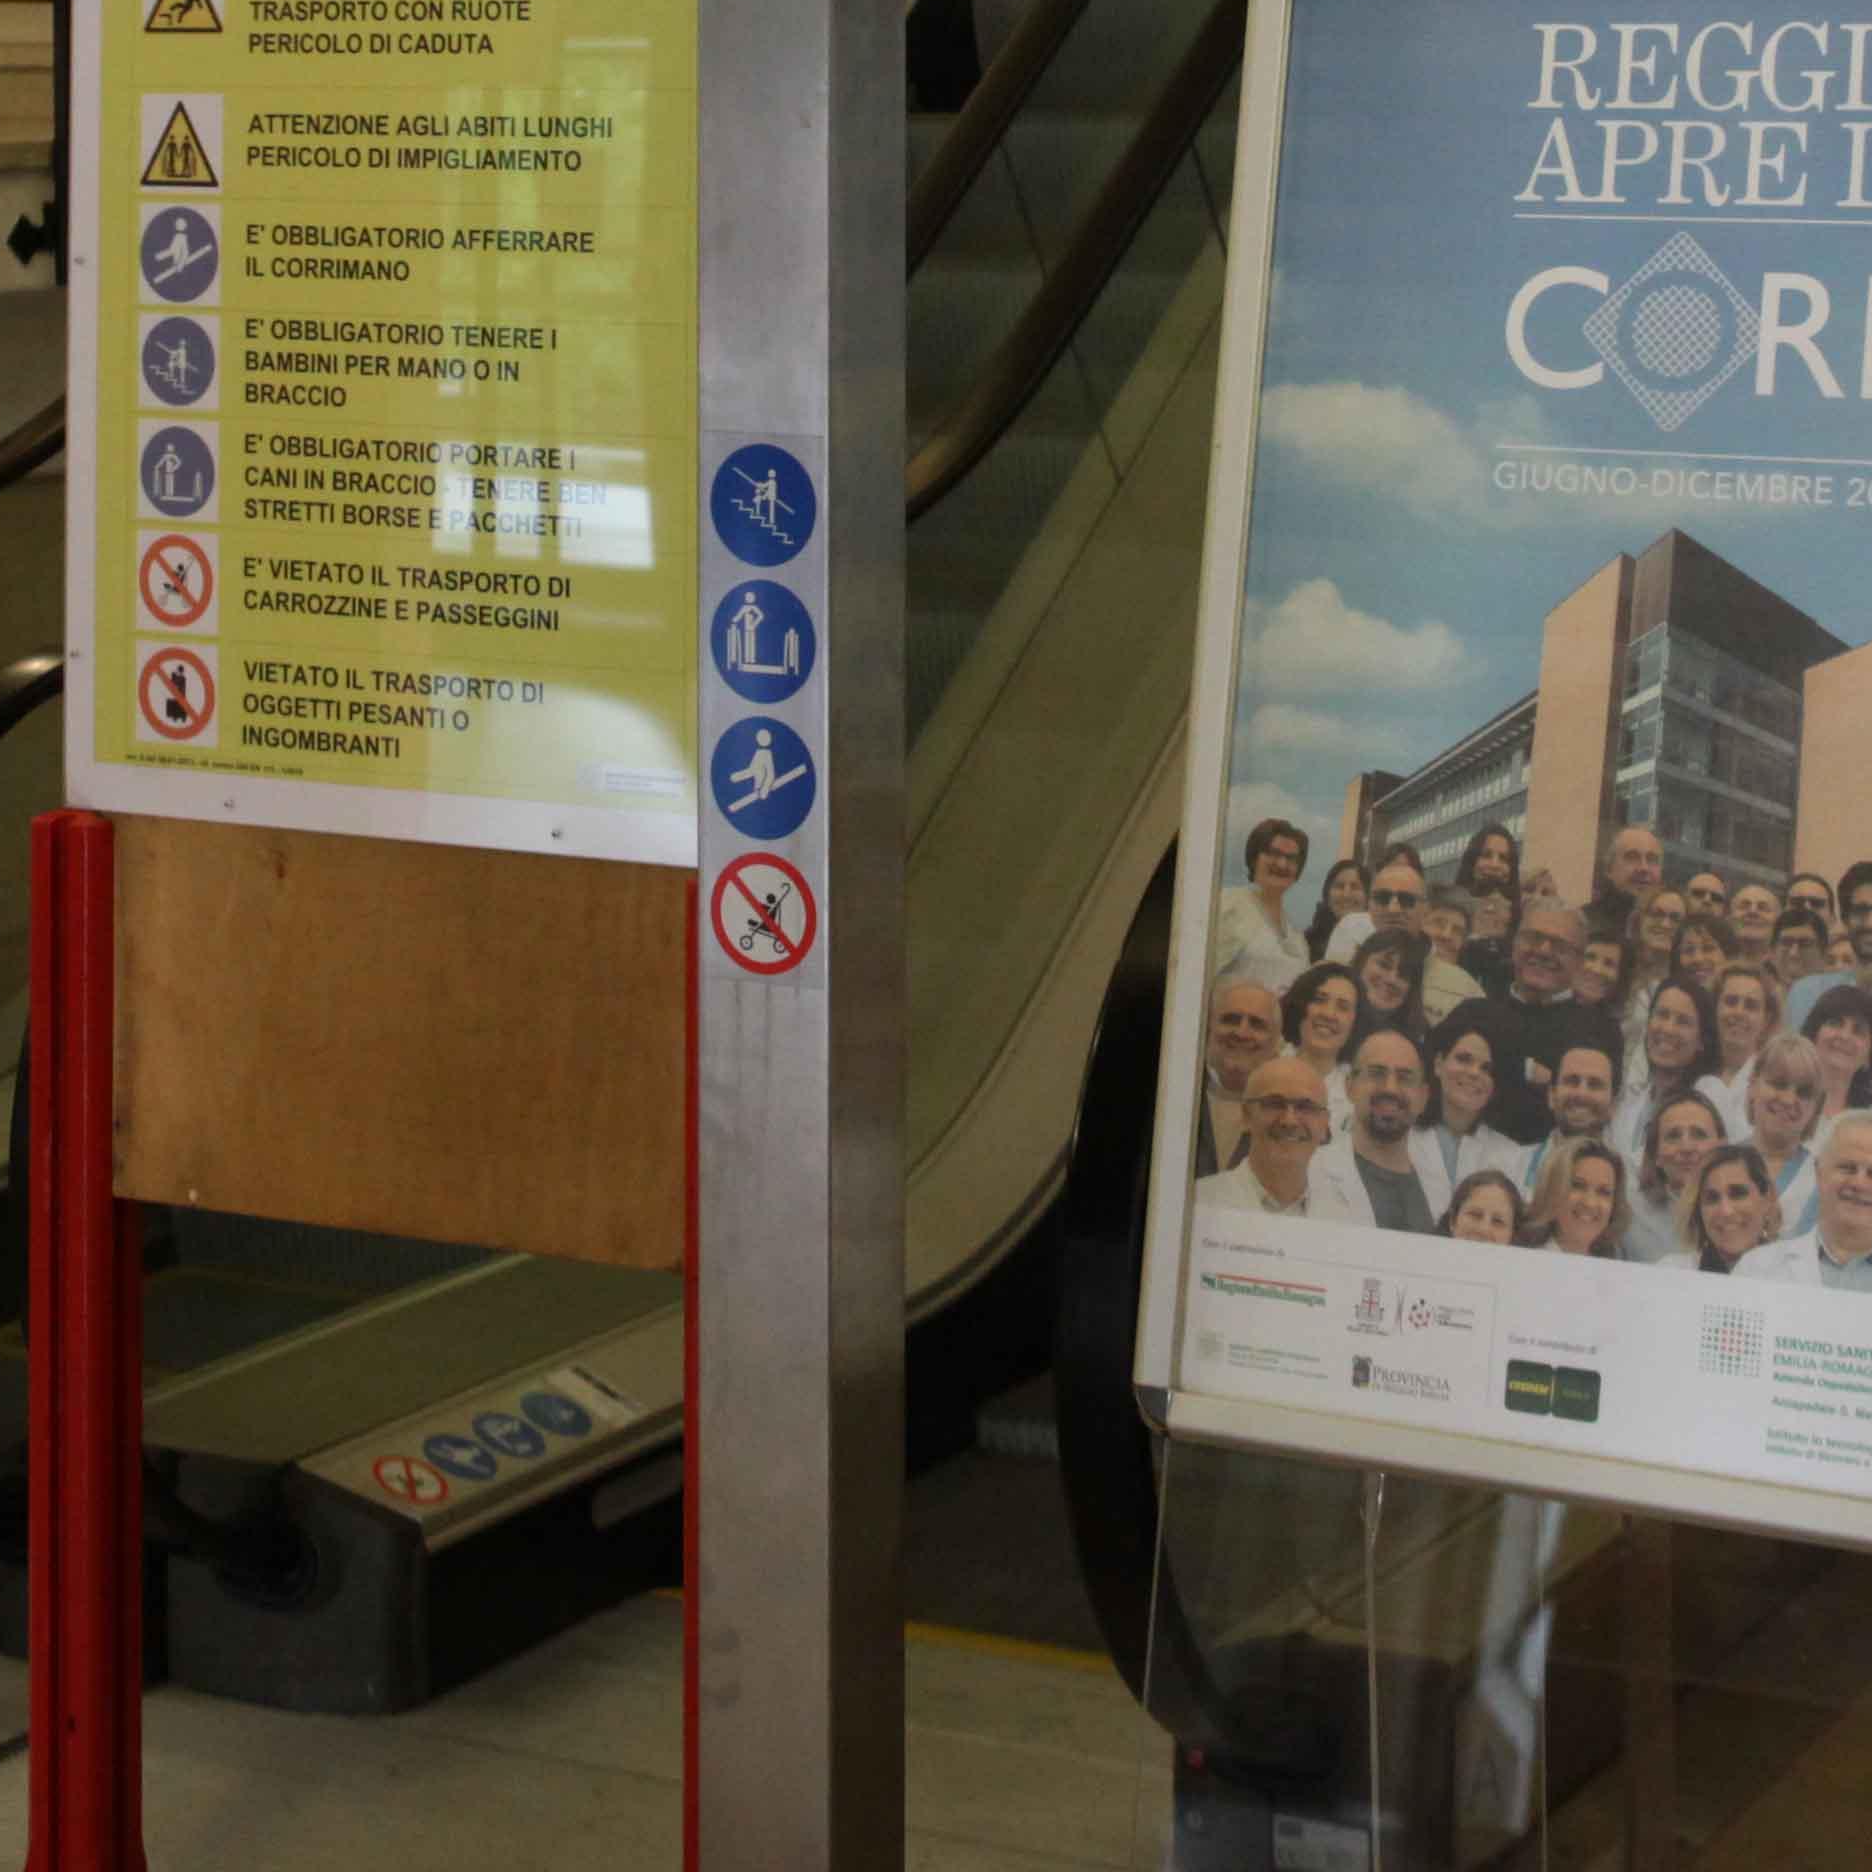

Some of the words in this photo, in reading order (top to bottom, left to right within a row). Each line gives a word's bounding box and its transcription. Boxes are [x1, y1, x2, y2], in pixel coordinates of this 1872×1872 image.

[251, 0, 387, 23] TRASPORTO
[394, 0, 444, 22] CON
[452, 0, 531, 22] RUOTE
[249, 34, 362, 56] PERICOLO
[370, 33, 390, 55] DI
[399, 33, 494, 54] CADUTA
[248, 114, 389, 137] ATTENZIONE
[396, 116, 450, 138] AGLI
[457, 116, 517, 139] ABITI
[524, 117, 612, 139] LUNGHI
[247, 146, 360, 169] PERICOLO
[367, 147, 389, 169] DI
[397, 148, 582, 172] IMPIGLIAMENTO
[1513, 118, 1808, 208] APRE
[246, 224, 266, 247] E'
[271, 225, 444, 252] OBBLIGATORIO
[452, 229, 594, 254] AFFERRARE
[246, 257, 264, 279] IL
[271, 258, 410, 282] CORRIMANO
[246, 319, 266, 340] E'
[270, 320, 444, 347] OBBLIGATORIO
[453, 326, 543, 349] TENERE
[550, 330, 557, 350] I
[245, 351, 338, 375] BAMBINI
[344, 355, 389, 377] PER
[397, 357, 466, 380] MANO
[474, 360, 490, 381] O
[497, 362, 520, 382] IN
[245, 384, 347, 407] BRACCIO
[244, 434, 264, 456] E'
[270, 435, 442, 464] OBBLIGATORIO
[450, 444, 561, 469] PORTARE
[569, 449, 576, 470] I
[244, 466, 297, 489] CANI
[304, 469, 325, 489] IN
[332, 470, 436, 497] BRACCIO
[453, 476, 550, 504] TENERE
[559, 482, 607, 506] BEN
[1493, 462, 1833, 508] GIUGNO-DICEMBRE
[244, 499, 336, 524] STRETTI
[342, 504, 420, 529] BORSE
[429, 509, 443, 530] E
[450, 510, 582, 539] PACCHETTI
[244, 557, 264, 580] E'
[269, 559, 362, 586] VIETATO
[371, 564, 390, 587] IL
[397, 566, 541, 597] TRASPORTO
[549, 575, 571, 598] DI
[244, 589, 387, 619] CARROZZINE
[395, 598, 409, 620] E
[417, 600, 559, 631] PASSEGGINI
[244, 661, 338, 689] VIETATO
[345, 667, 364, 691] IL
[372, 669, 514, 704] TRASPORTO
[522, 680, 544, 705] DI
[243, 692, 342, 722] OGGETTI
[349, 700, 446, 729] PESANTI
[452, 709, 469, 732] O
[242, 724, 400, 759] INGOMBRANTI
[1775, 1336, 1833, 1356] SERVIZIO
